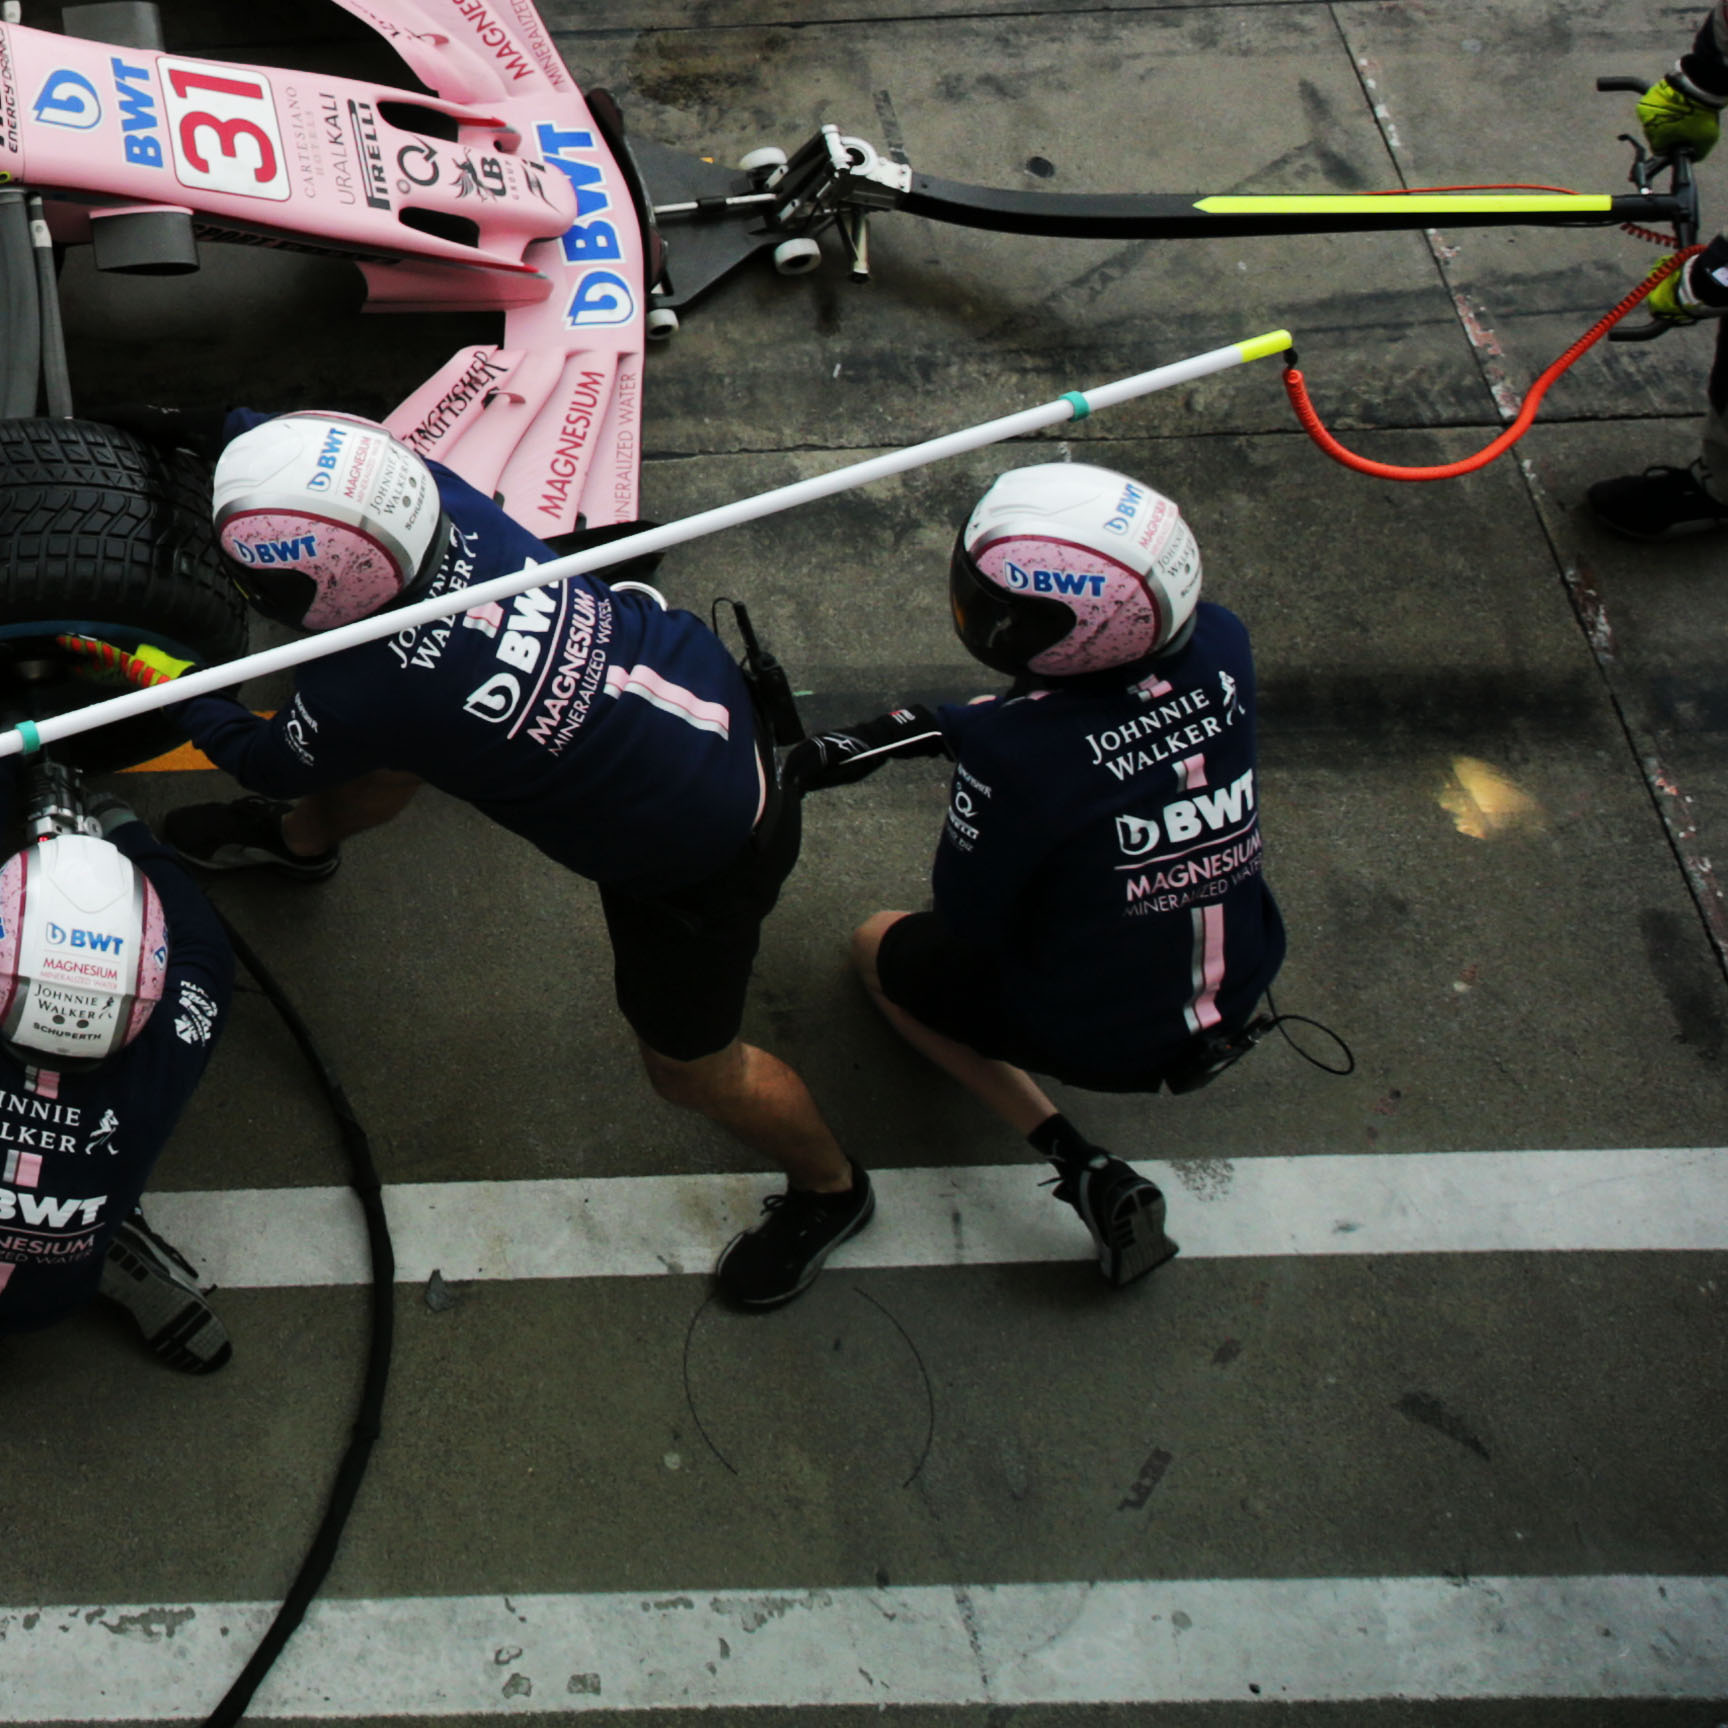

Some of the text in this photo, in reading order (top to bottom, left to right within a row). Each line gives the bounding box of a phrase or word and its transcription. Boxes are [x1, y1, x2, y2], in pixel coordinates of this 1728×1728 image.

[6, 84, 22, 155] ENERGY
[112, 57, 165, 168] BWT
[168, 69, 277, 184] 31
[285, 85, 315, 199] CARTESIANO
[319, 92, 356, 205] URALKALI
[347, 98, 392, 211] PIRELLI
[537, 122, 626, 263] BWT
[317, 428, 347, 470] BWT
[344, 436, 372, 498] MAGNESIUM
[538, 371, 605, 520] MAGNESIUM
[614, 373, 637, 524] INERALIZED WATER
[370, 456, 398, 515] JOHNNIE
[384, 462, 408, 515] WALKER
[405, 474, 427, 531] SCHUBERTH
[1117, 483, 1144, 518] BWT
[254, 535, 317, 563] BWT
[1033, 570, 1105, 597] BWT
[527, 588, 595, 747] MAGNESIUM
[548, 648, 604, 758] MINERALIZED
[1085, 688, 1210, 765] JOHNNIE
[1106, 716, 1222, 781] WALKER
[1163, 768, 1254, 843] BWT
[1126, 832, 1262, 902] MAGNESIUM
[43, 958, 118, 981] MAGNESIUM
[70, 929, 124, 956] BWT
[35, 984, 98, 1006] JOHNNIE
[38, 1000, 96, 1019] WALKER
